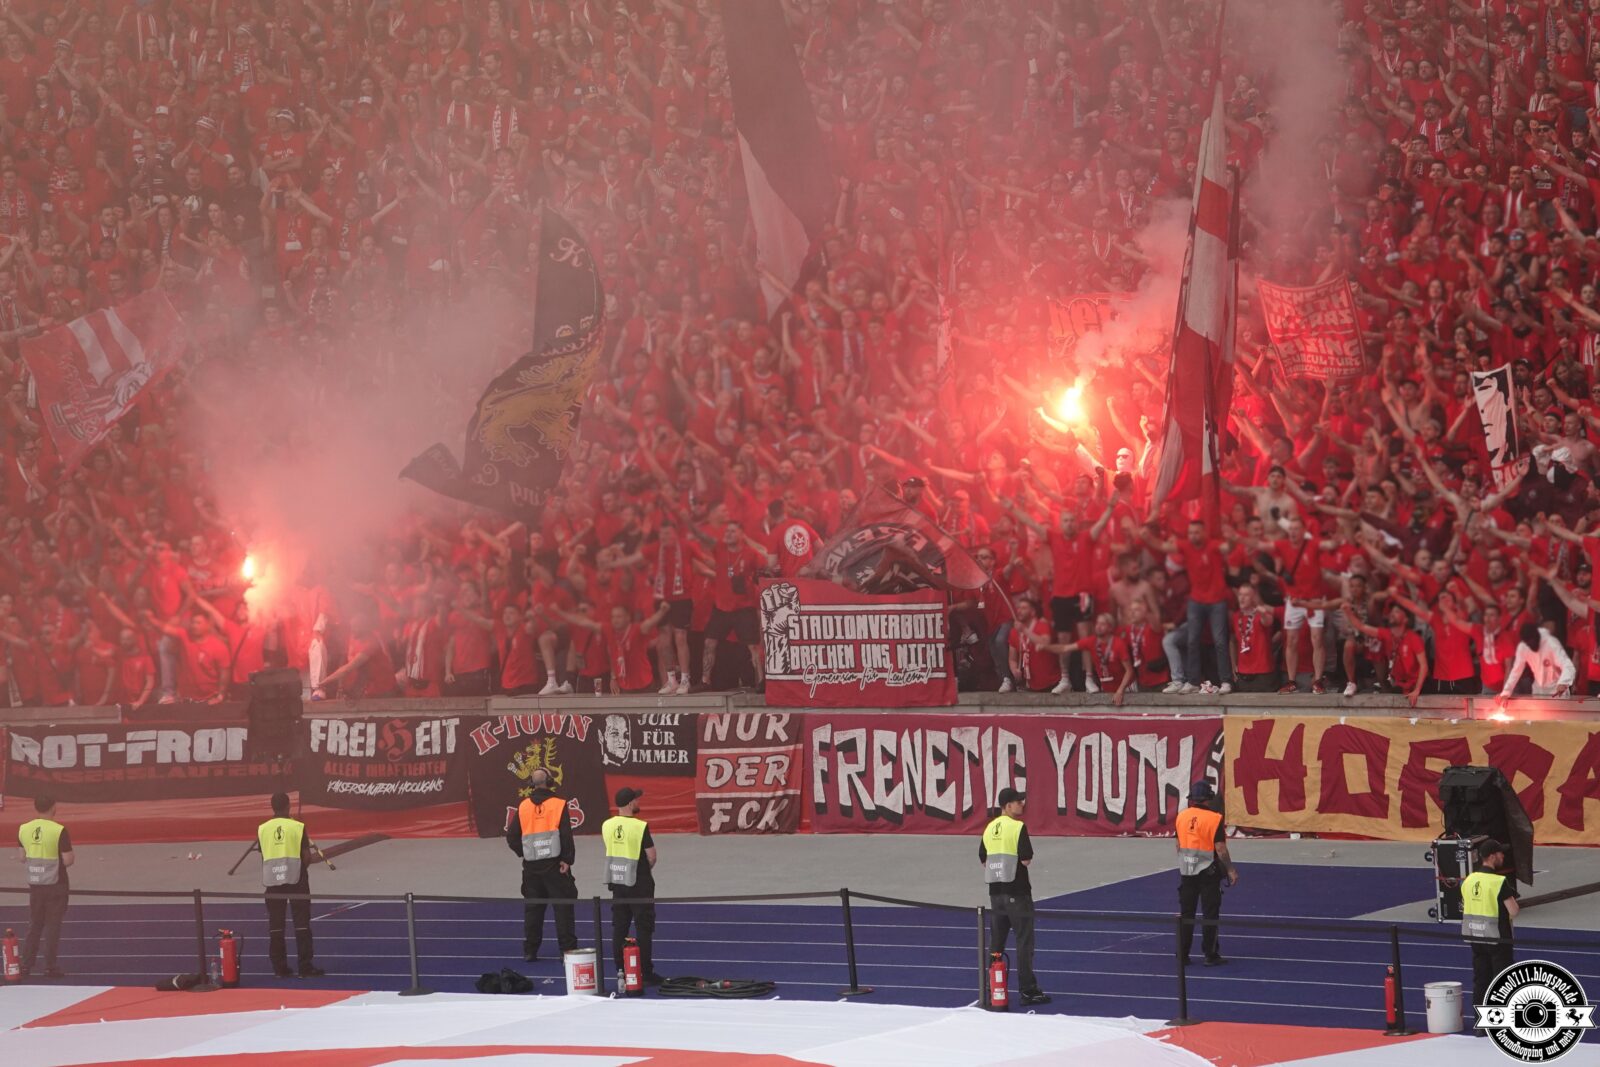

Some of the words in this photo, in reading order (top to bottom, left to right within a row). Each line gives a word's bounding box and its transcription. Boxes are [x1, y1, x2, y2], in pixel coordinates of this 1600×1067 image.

[788, 613, 945, 640] STADIONVERBOTE
[789, 643, 855, 670] BRECHEN
[861, 643, 891, 669] UNS
[896, 643, 946, 669] NICHT
[470, 713, 593, 756] K-TOWN
[642, 728, 676, 746] FÜR
[703, 713, 791, 742] NUR
[631, 748, 690, 764] IMMER
[705, 754, 790, 788] DER
[812, 723, 1027, 822] FRENETIC
[1044, 728, 1194, 826] YOUTH
[709, 798, 789, 833] FCK
